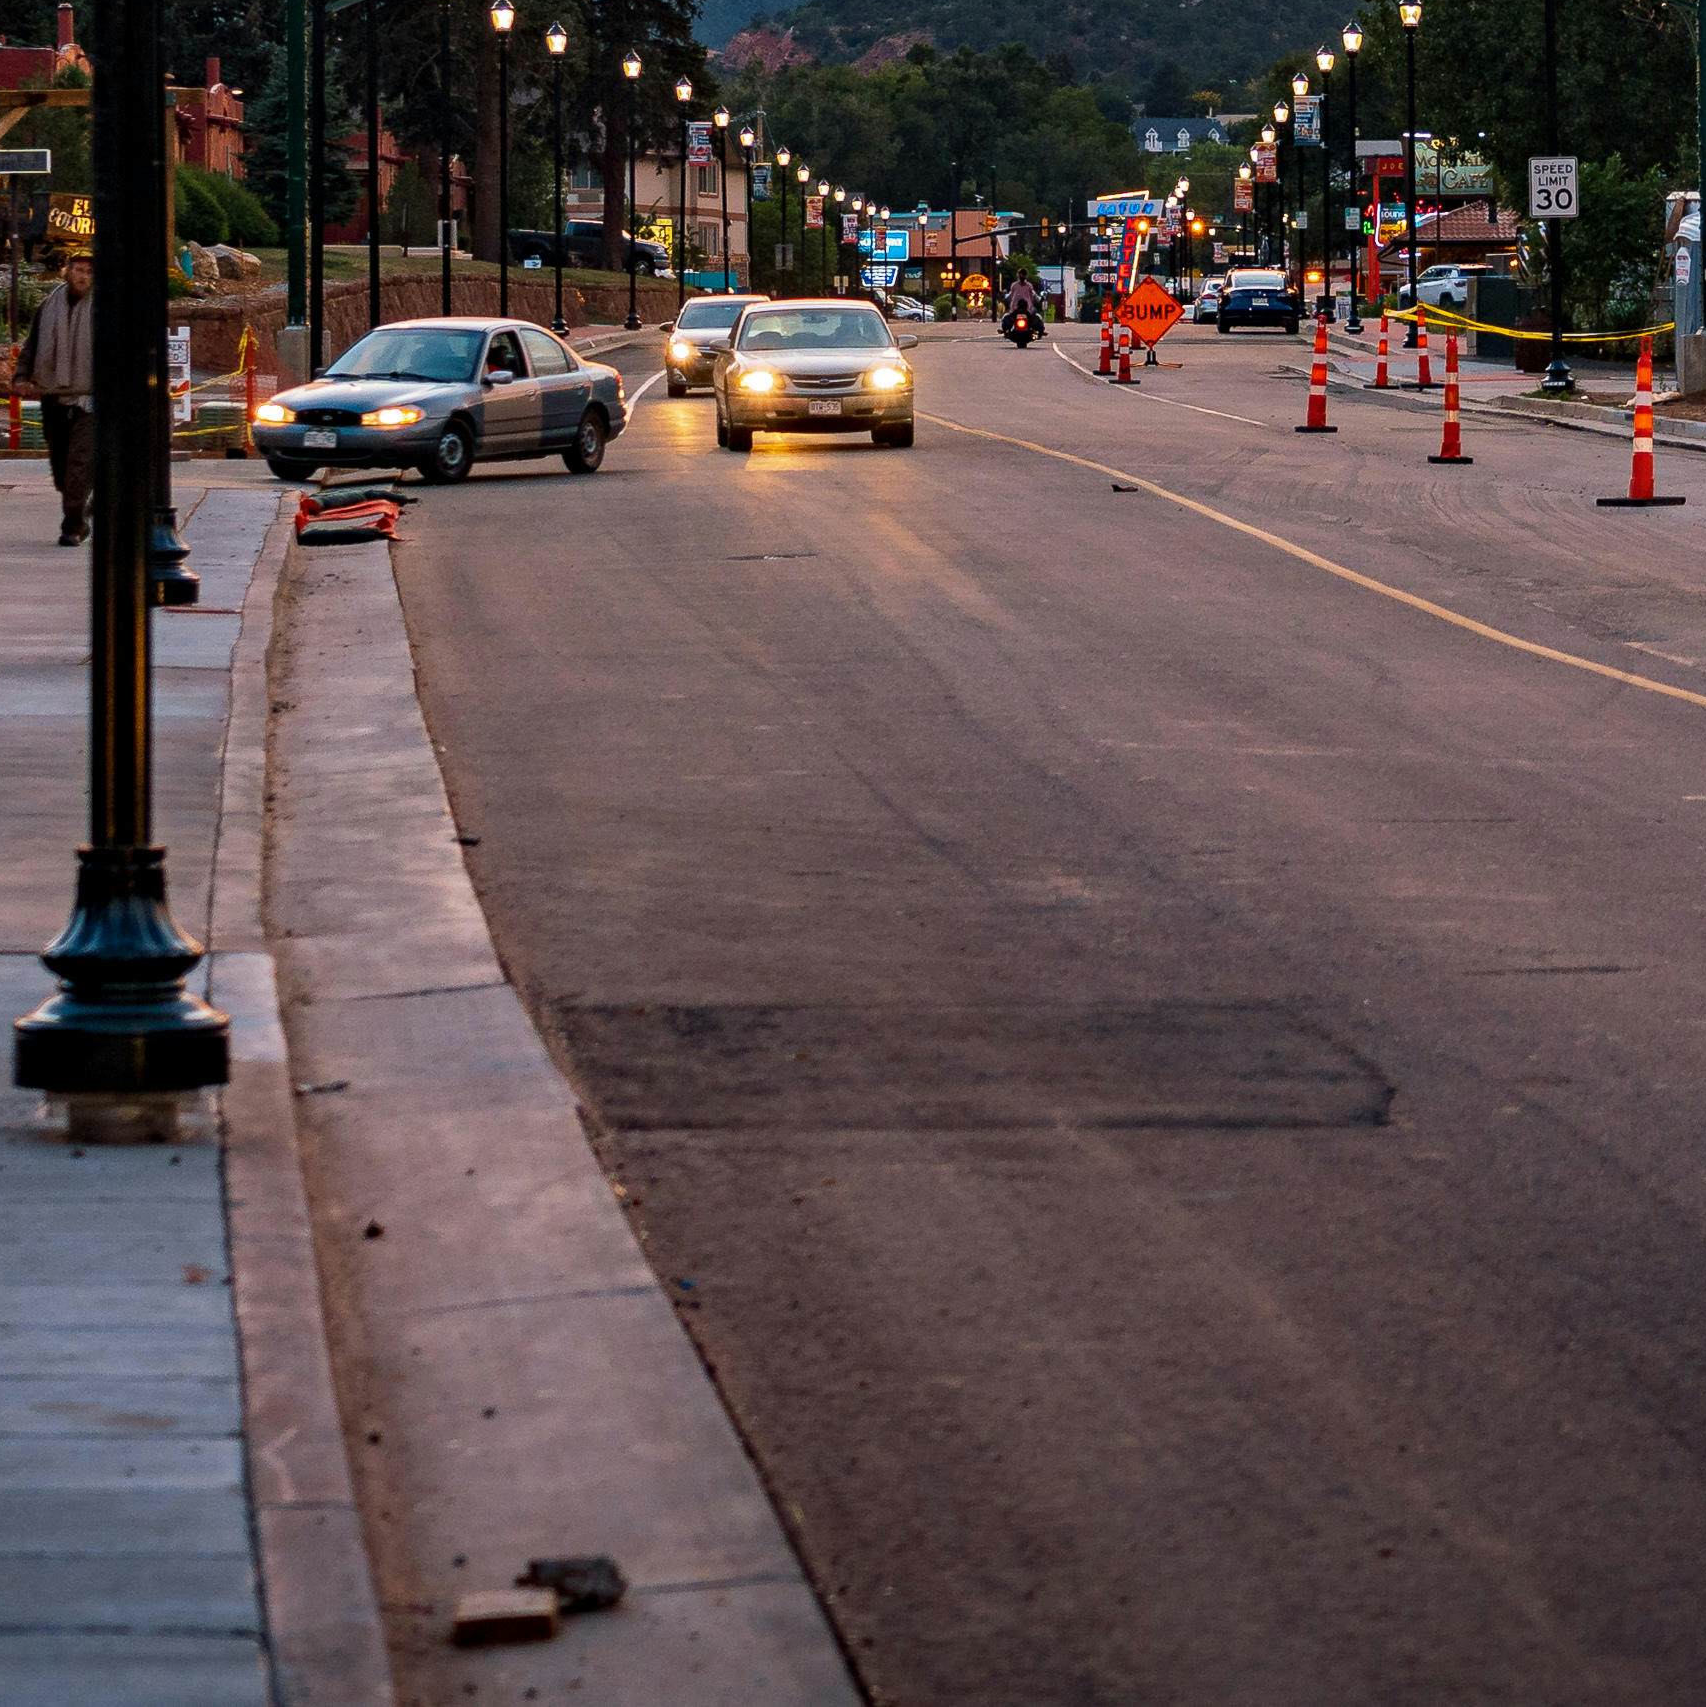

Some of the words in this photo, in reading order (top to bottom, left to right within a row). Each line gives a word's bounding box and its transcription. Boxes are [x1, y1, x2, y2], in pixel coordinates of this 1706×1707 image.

[1533, 164, 1573, 175] SPEED
[1538, 176, 1569, 186] LIMIT
[72, 198, 92, 216] EL
[1536, 188, 1573, 210] 30
[1124, 304, 1175, 320] BUMP
